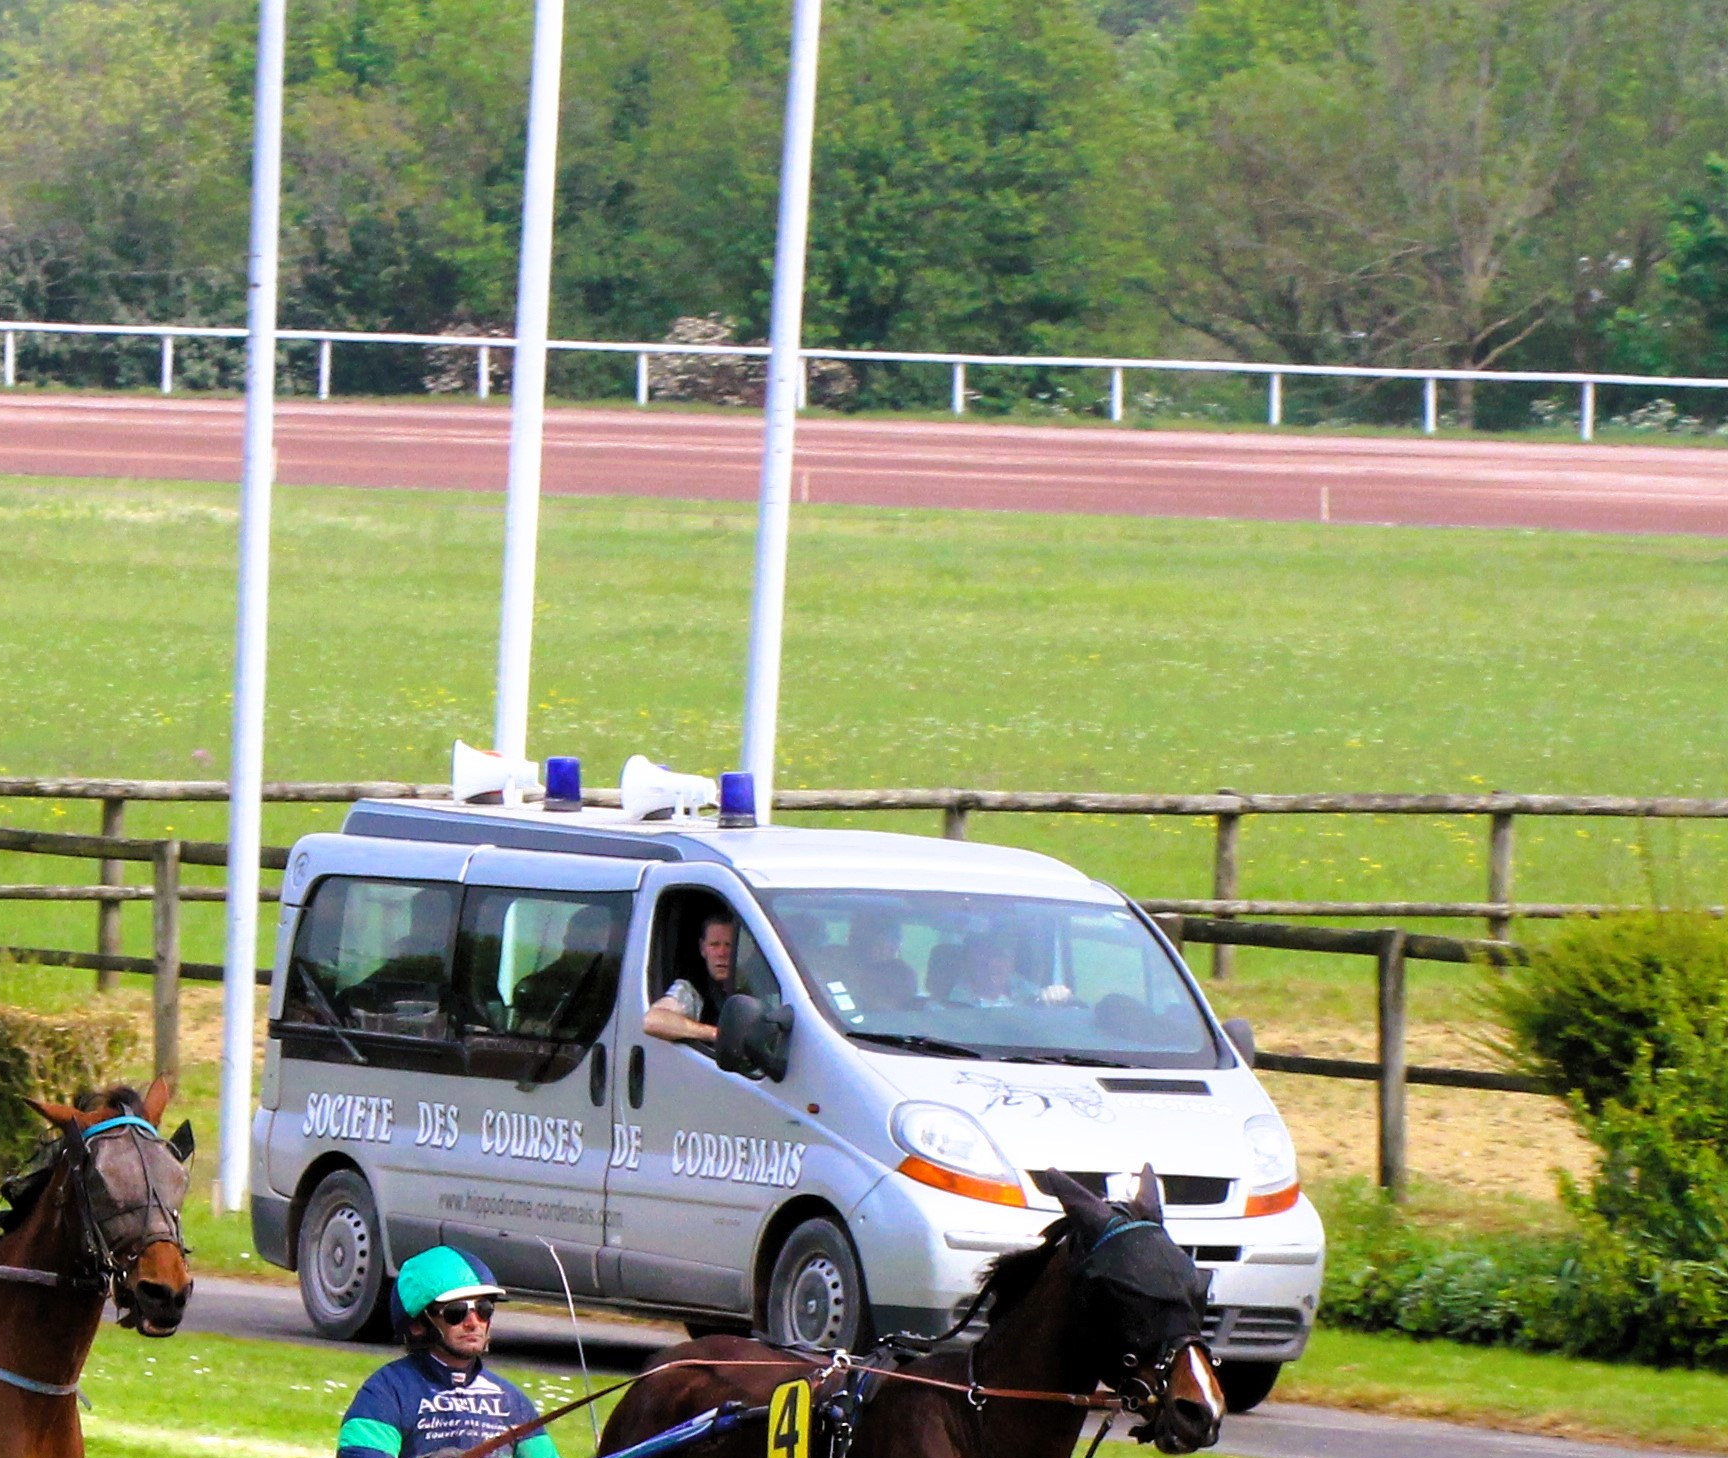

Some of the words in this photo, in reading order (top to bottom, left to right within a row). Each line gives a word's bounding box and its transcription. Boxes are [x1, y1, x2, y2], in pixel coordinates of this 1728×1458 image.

[302, 1092, 393, 1143] SOCIETE
[414, 1101, 459, 1150] DES
[480, 1108, 584, 1166] COURSES
[610, 1122, 643, 1171] DE
[671, 1129, 807, 1188] CORDEMAIS
[417, 1394, 511, 1417] AGRIAL
